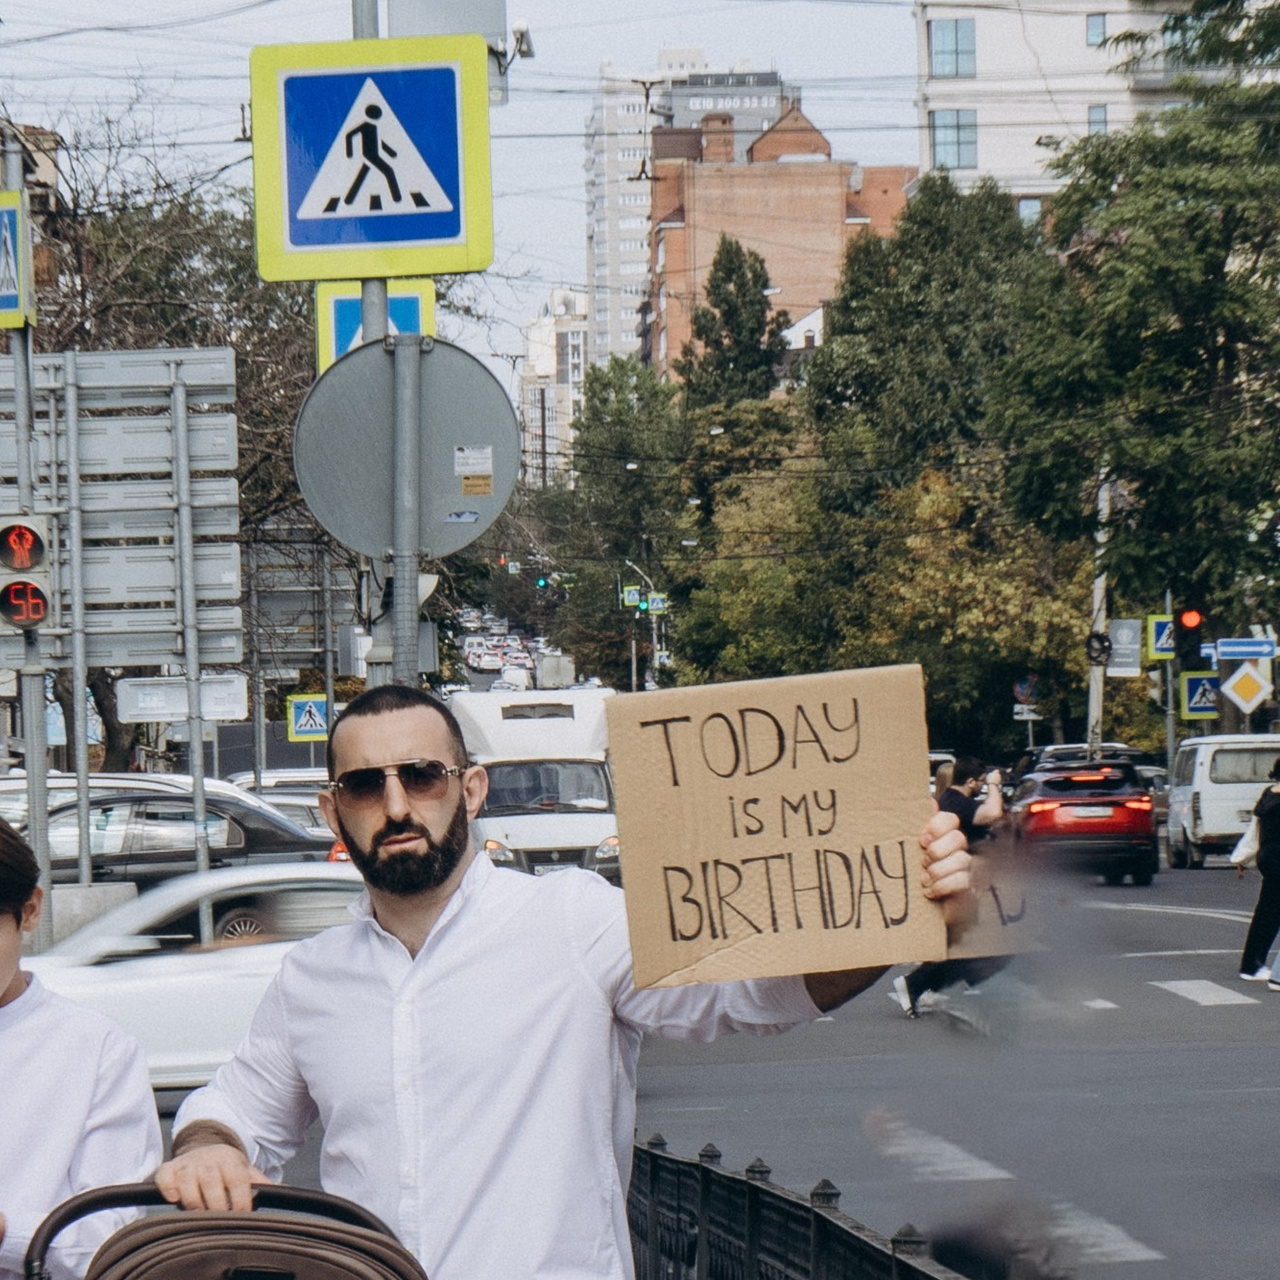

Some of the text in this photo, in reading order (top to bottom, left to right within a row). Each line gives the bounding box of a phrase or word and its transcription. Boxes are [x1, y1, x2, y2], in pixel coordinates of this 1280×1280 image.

[9, 584, 45, 621] 56
[639, 697, 861, 787] TODAY
[781, 788, 836, 838] MY
[663, 840, 909, 942] BIRTHDAY
